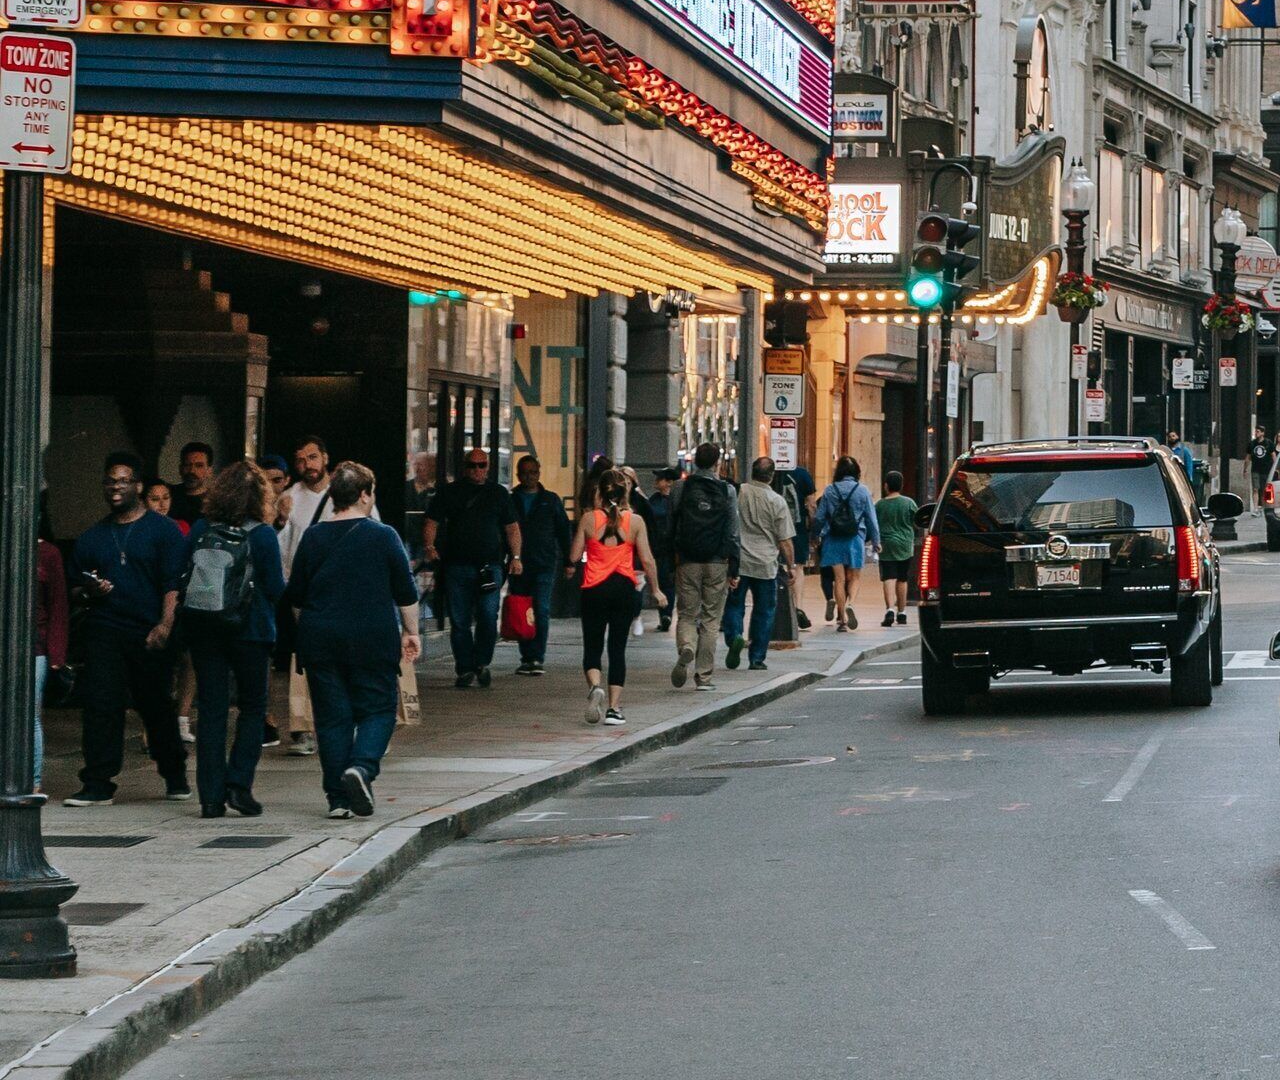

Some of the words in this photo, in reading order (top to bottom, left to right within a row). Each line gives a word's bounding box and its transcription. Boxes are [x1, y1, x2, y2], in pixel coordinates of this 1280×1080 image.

[16, 5, 73, 16] EMERGENCY
[6, 46, 37, 66] TOW
[39, 49, 70, 70] ZONE
[24, 77, 52, 94] NO
[4, 95, 66, 111] STOPPING
[24, 111, 49, 122] ANY
[23, 123, 50, 135] TIME
[827, 215, 887, 240] OCK
[989, 213, 1008, 239] JUNE
[1047, 570, 1079, 582] 71540
